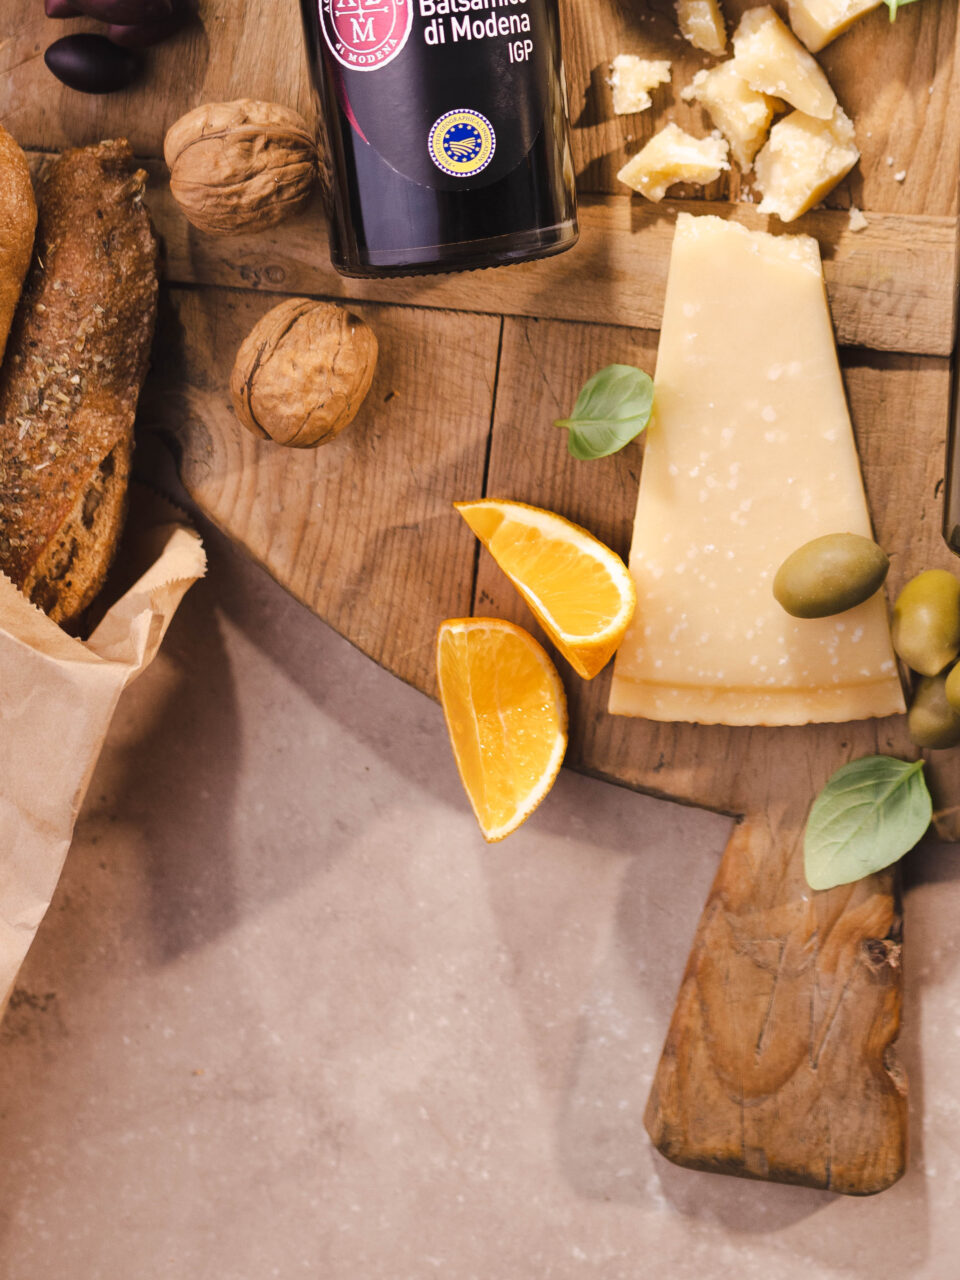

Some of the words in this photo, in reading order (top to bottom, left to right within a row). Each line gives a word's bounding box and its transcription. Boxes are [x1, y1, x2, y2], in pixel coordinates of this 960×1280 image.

[424, 18, 446, 46] di
[451, 11, 531, 42] Modena
[348, 38, 398, 64] MODENA
[508, 39, 533, 64] IGP
